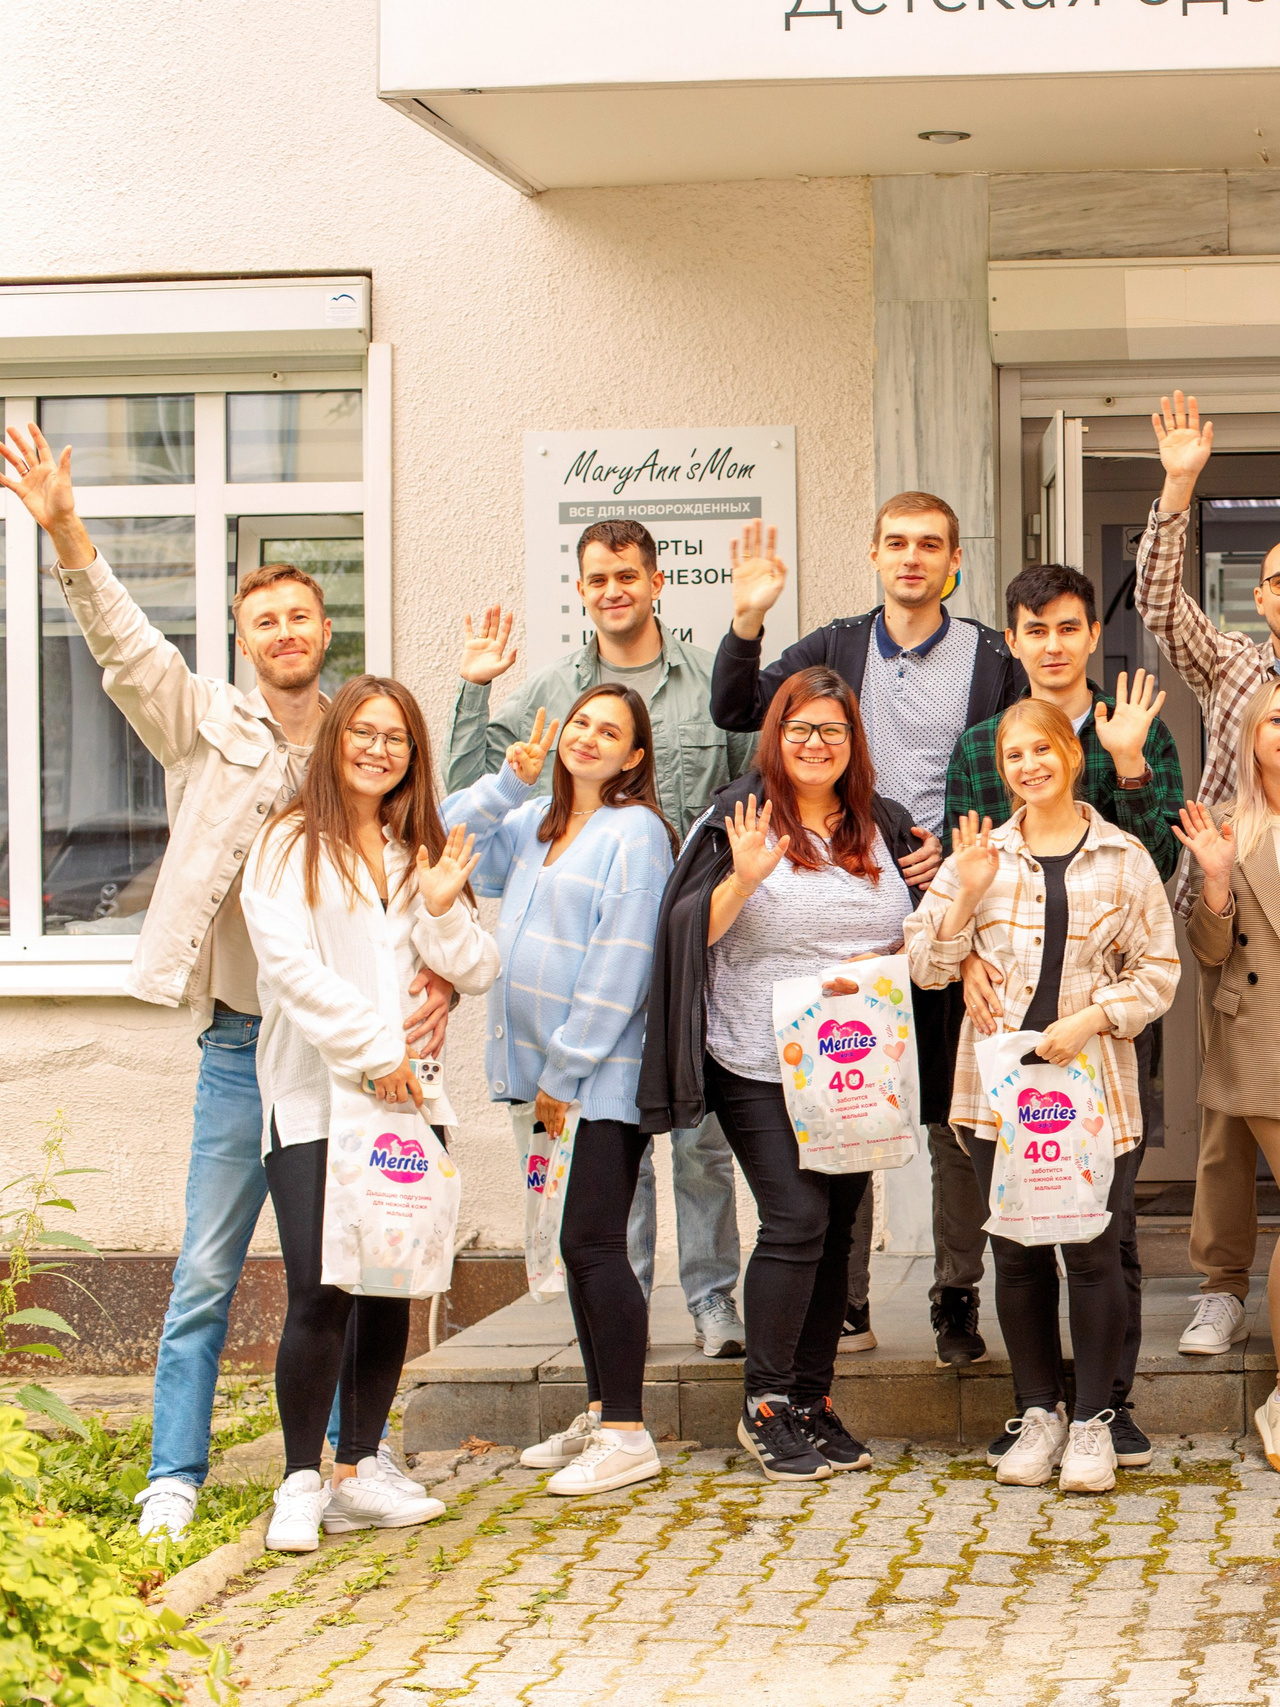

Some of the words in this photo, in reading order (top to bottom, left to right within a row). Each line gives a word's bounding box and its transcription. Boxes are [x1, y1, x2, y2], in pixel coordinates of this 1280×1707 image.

[563, 446, 756, 495] MaryAnn'sMom
[569, 507, 594, 517] ВСЕ
[598, 506, 625, 518] ДЛЯ
[628, 502, 751, 516] НОВОРОЖДЕННЫХ
[819, 1032, 877, 1056] Merries
[829, 1068, 865, 1093] 40
[1018, 1103, 1077, 1124] Merries
[369, 1149, 429, 1172] Merries
[1024, 1140, 1061, 1163] 40
